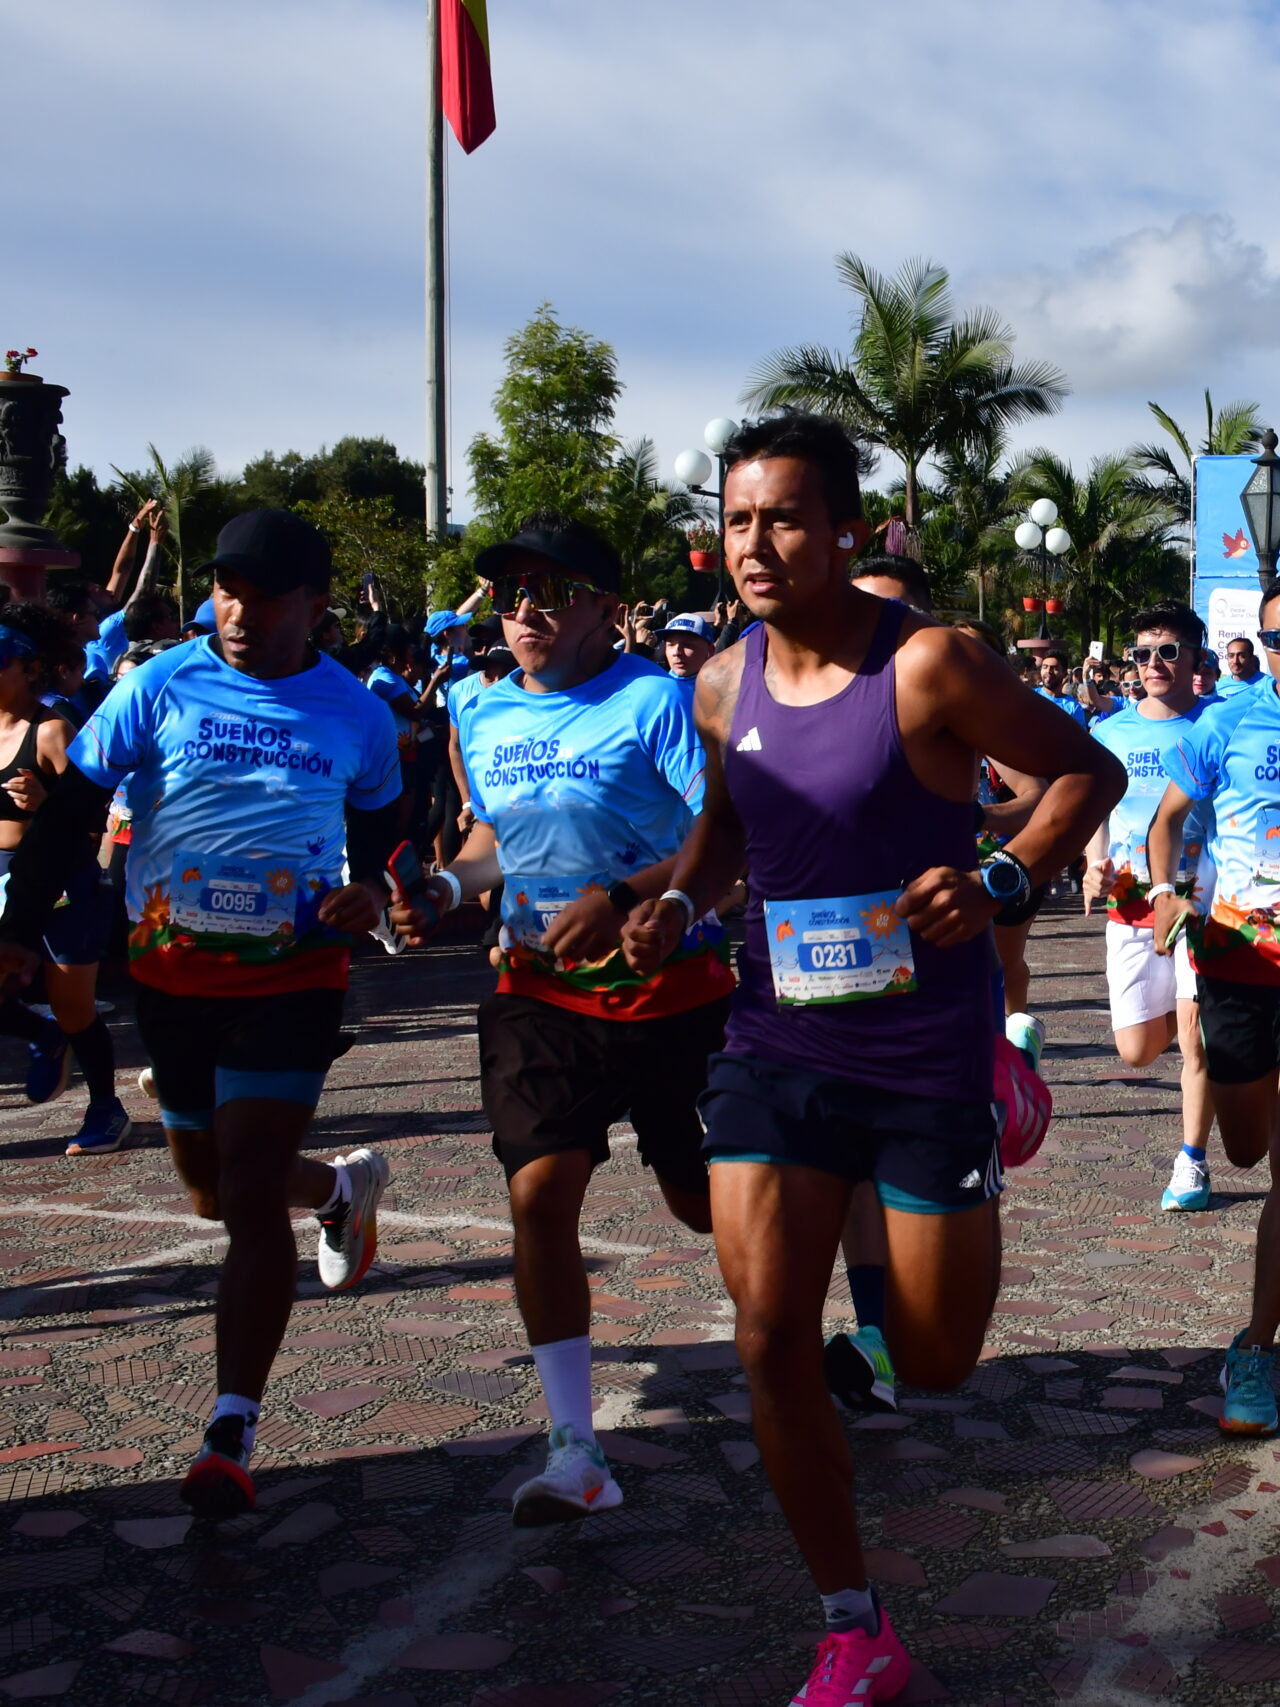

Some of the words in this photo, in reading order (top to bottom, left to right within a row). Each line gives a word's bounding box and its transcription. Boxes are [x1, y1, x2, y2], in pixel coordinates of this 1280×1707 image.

[1218, 630, 1246, 638] Renal
[198, 717, 292, 750] SUEÑOS
[184, 740, 333, 778] CONSTRUCCIÓN
[493, 737, 560, 768] SUEÑOS
[1127, 748, 1161, 767] SUEÑ
[485, 755, 600, 788] CONSTRUCCIÓN
[211, 891, 257, 913] 0095
[811, 943, 857, 969] 0231
